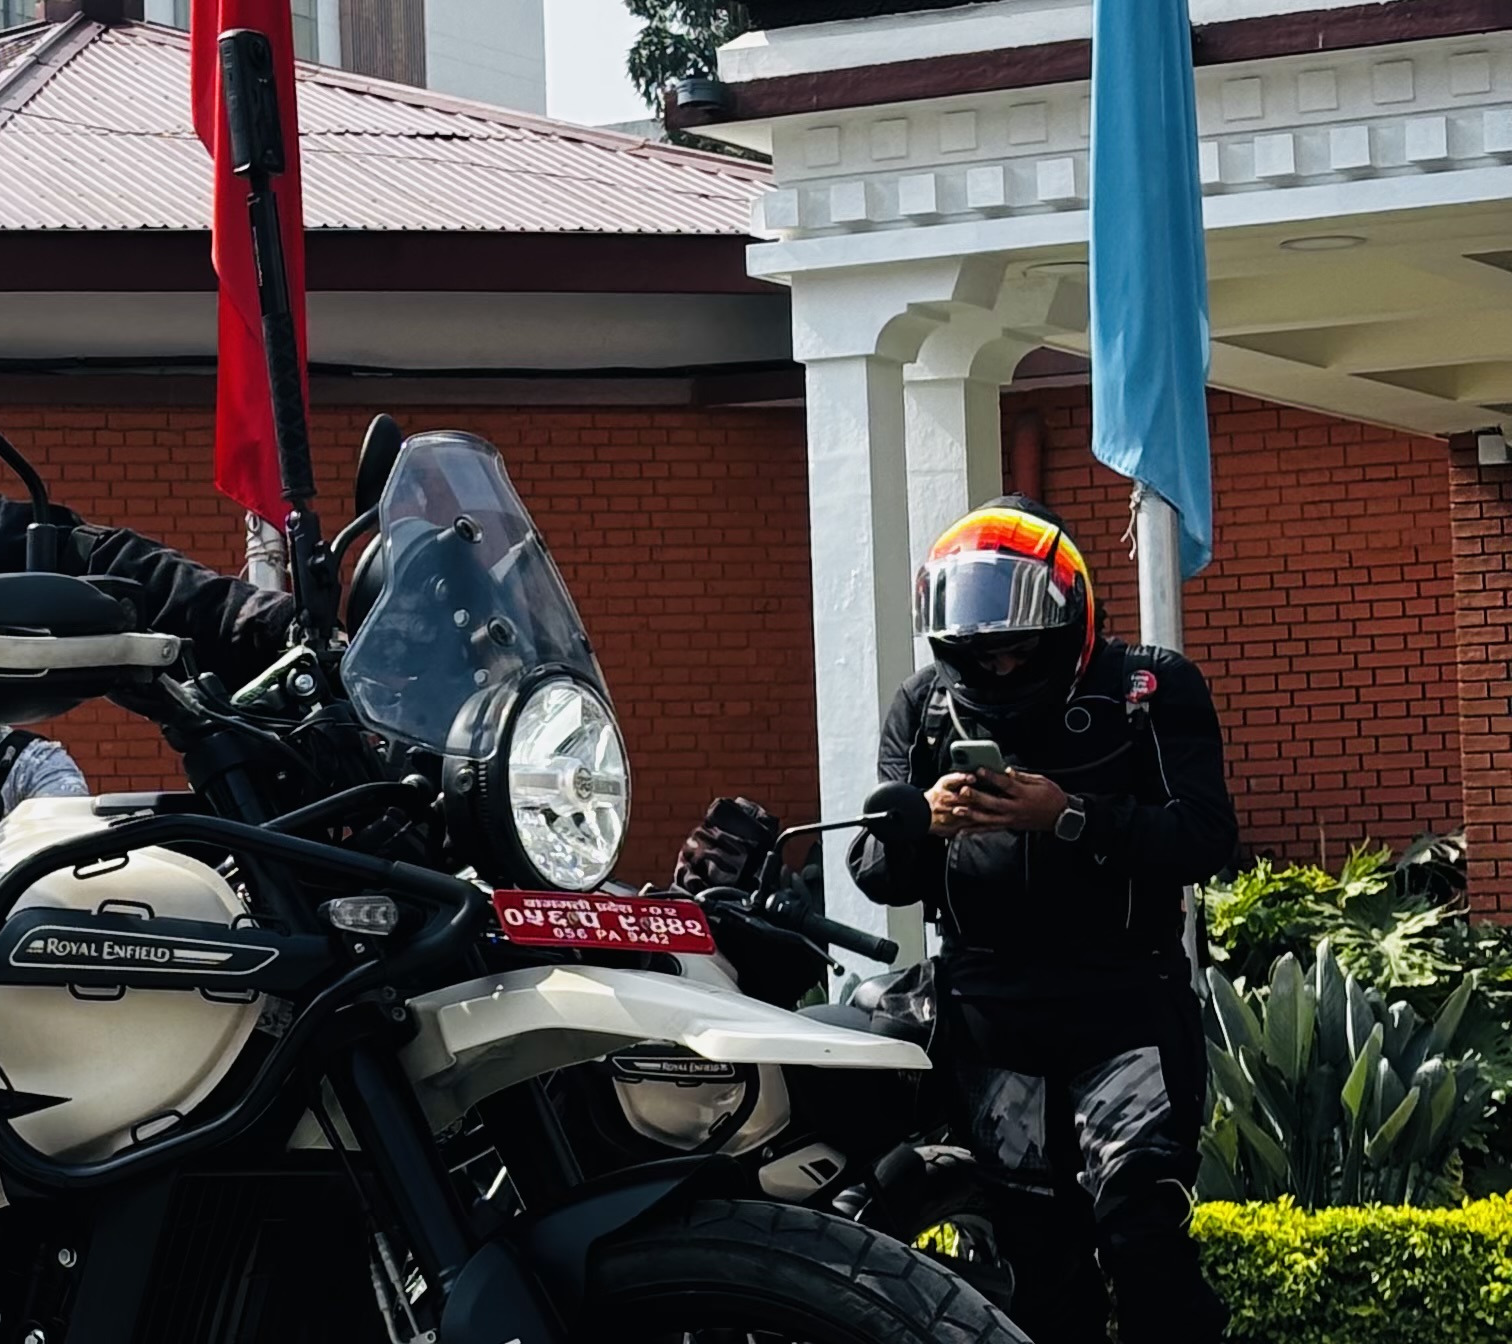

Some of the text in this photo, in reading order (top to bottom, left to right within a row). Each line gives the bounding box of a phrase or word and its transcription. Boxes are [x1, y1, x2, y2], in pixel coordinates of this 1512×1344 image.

[552, 927, 670, 945] 056 PA 9442
[46, 937, 170, 962] ROYAL ENFIELD
